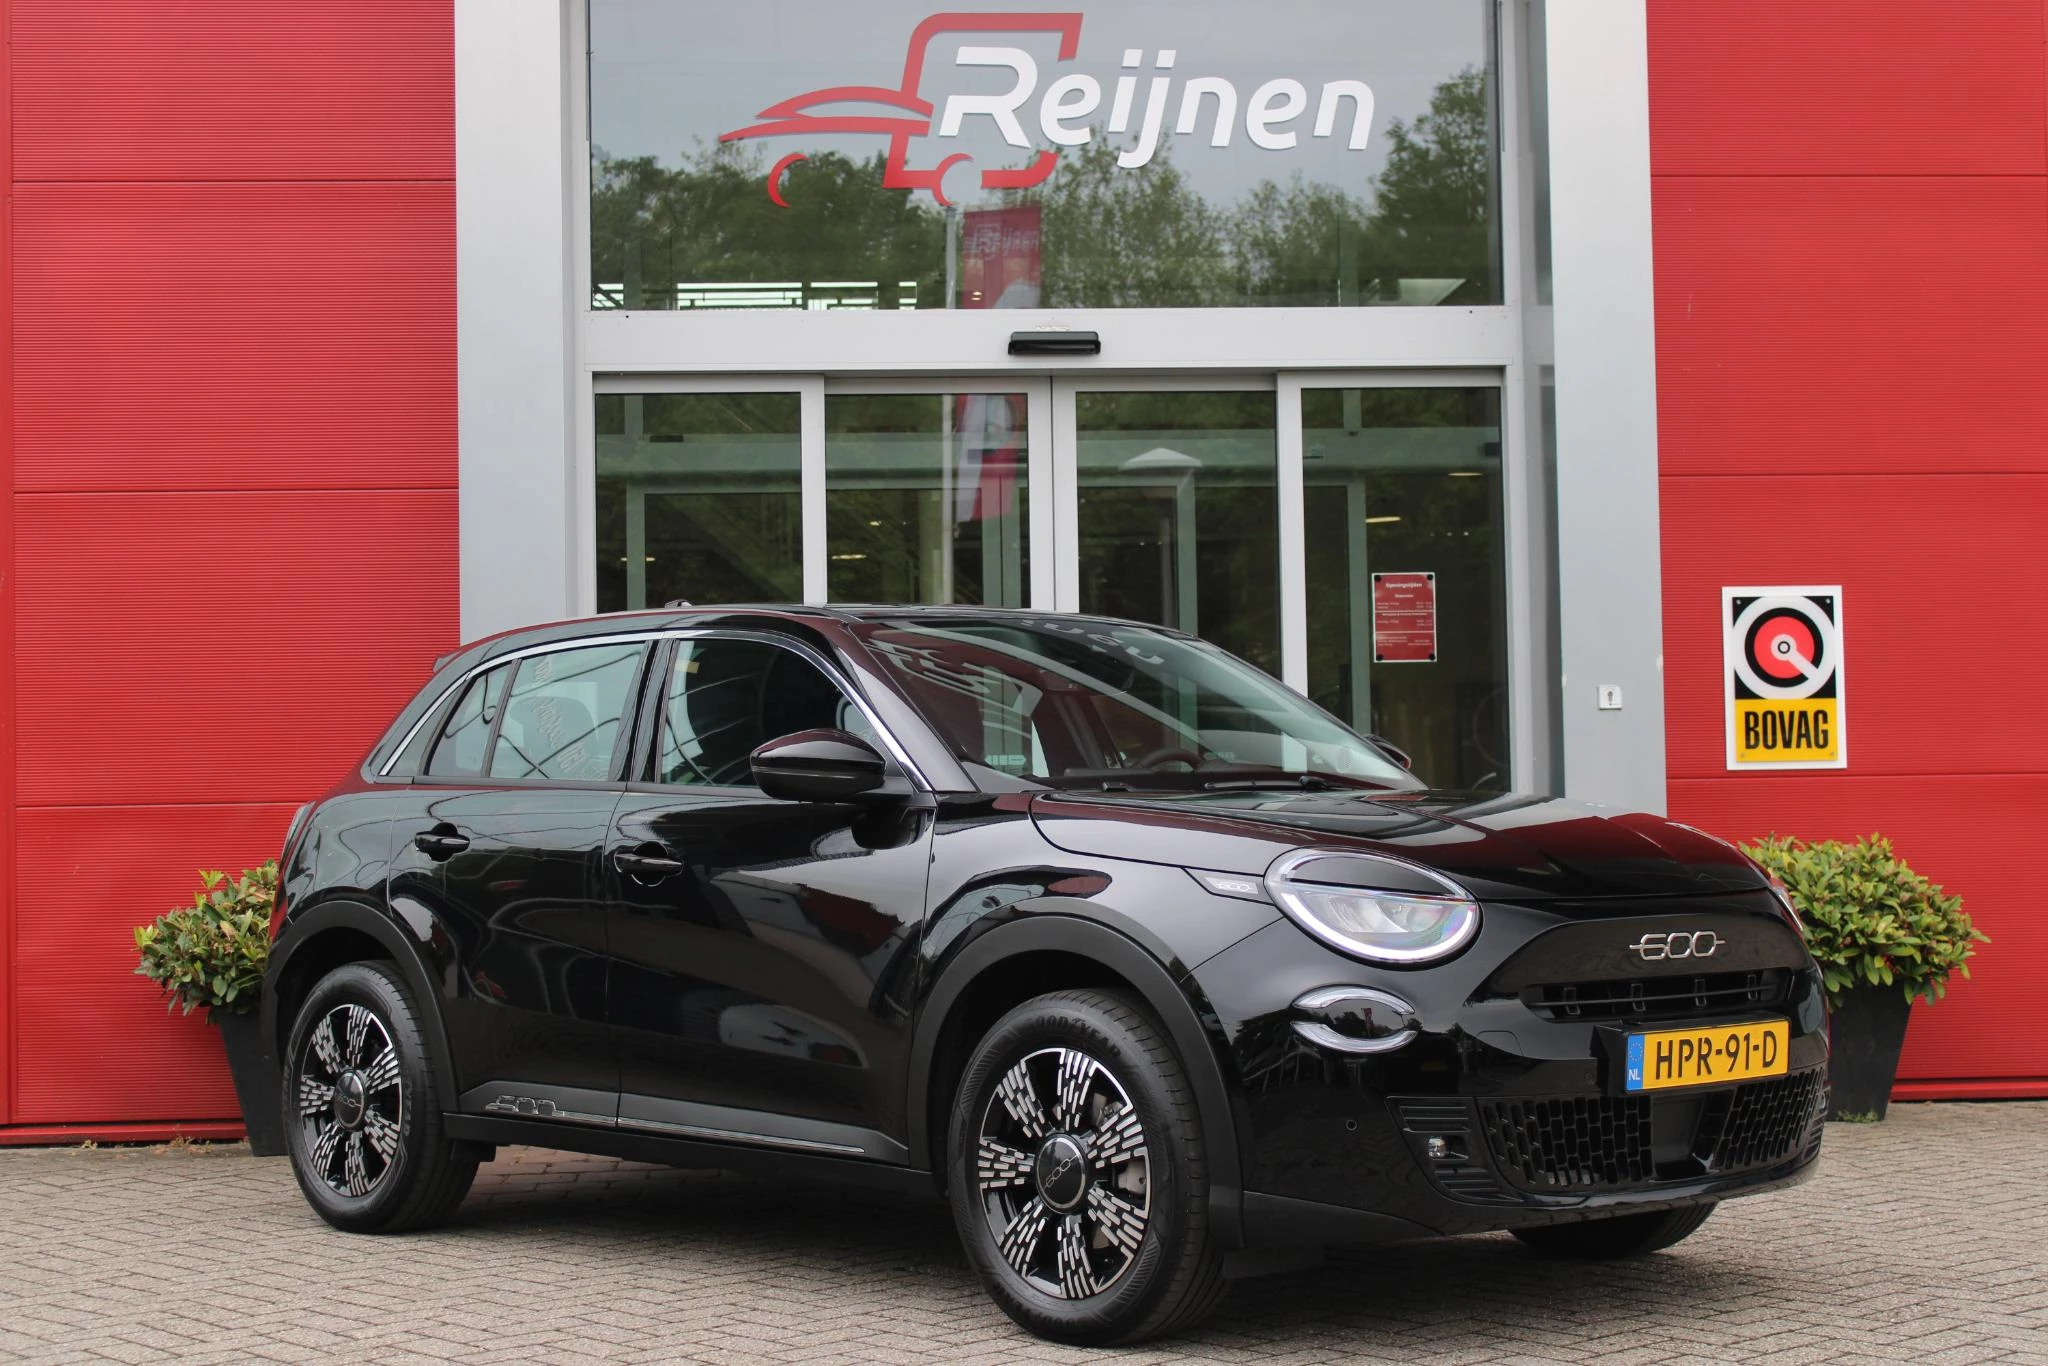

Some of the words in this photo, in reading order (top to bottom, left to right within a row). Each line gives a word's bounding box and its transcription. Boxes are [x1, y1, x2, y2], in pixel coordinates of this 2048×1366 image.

[940, 47, 1375, 168] Reijnen
[1744, 710, 1829, 750] BOVAG
[1629, 931, 1726, 960] 600
[1656, 1030, 1777, 1080] HPR-91-D
[1628, 1069, 1641, 1081] NL
[1045, 1157, 1074, 1188] 600
